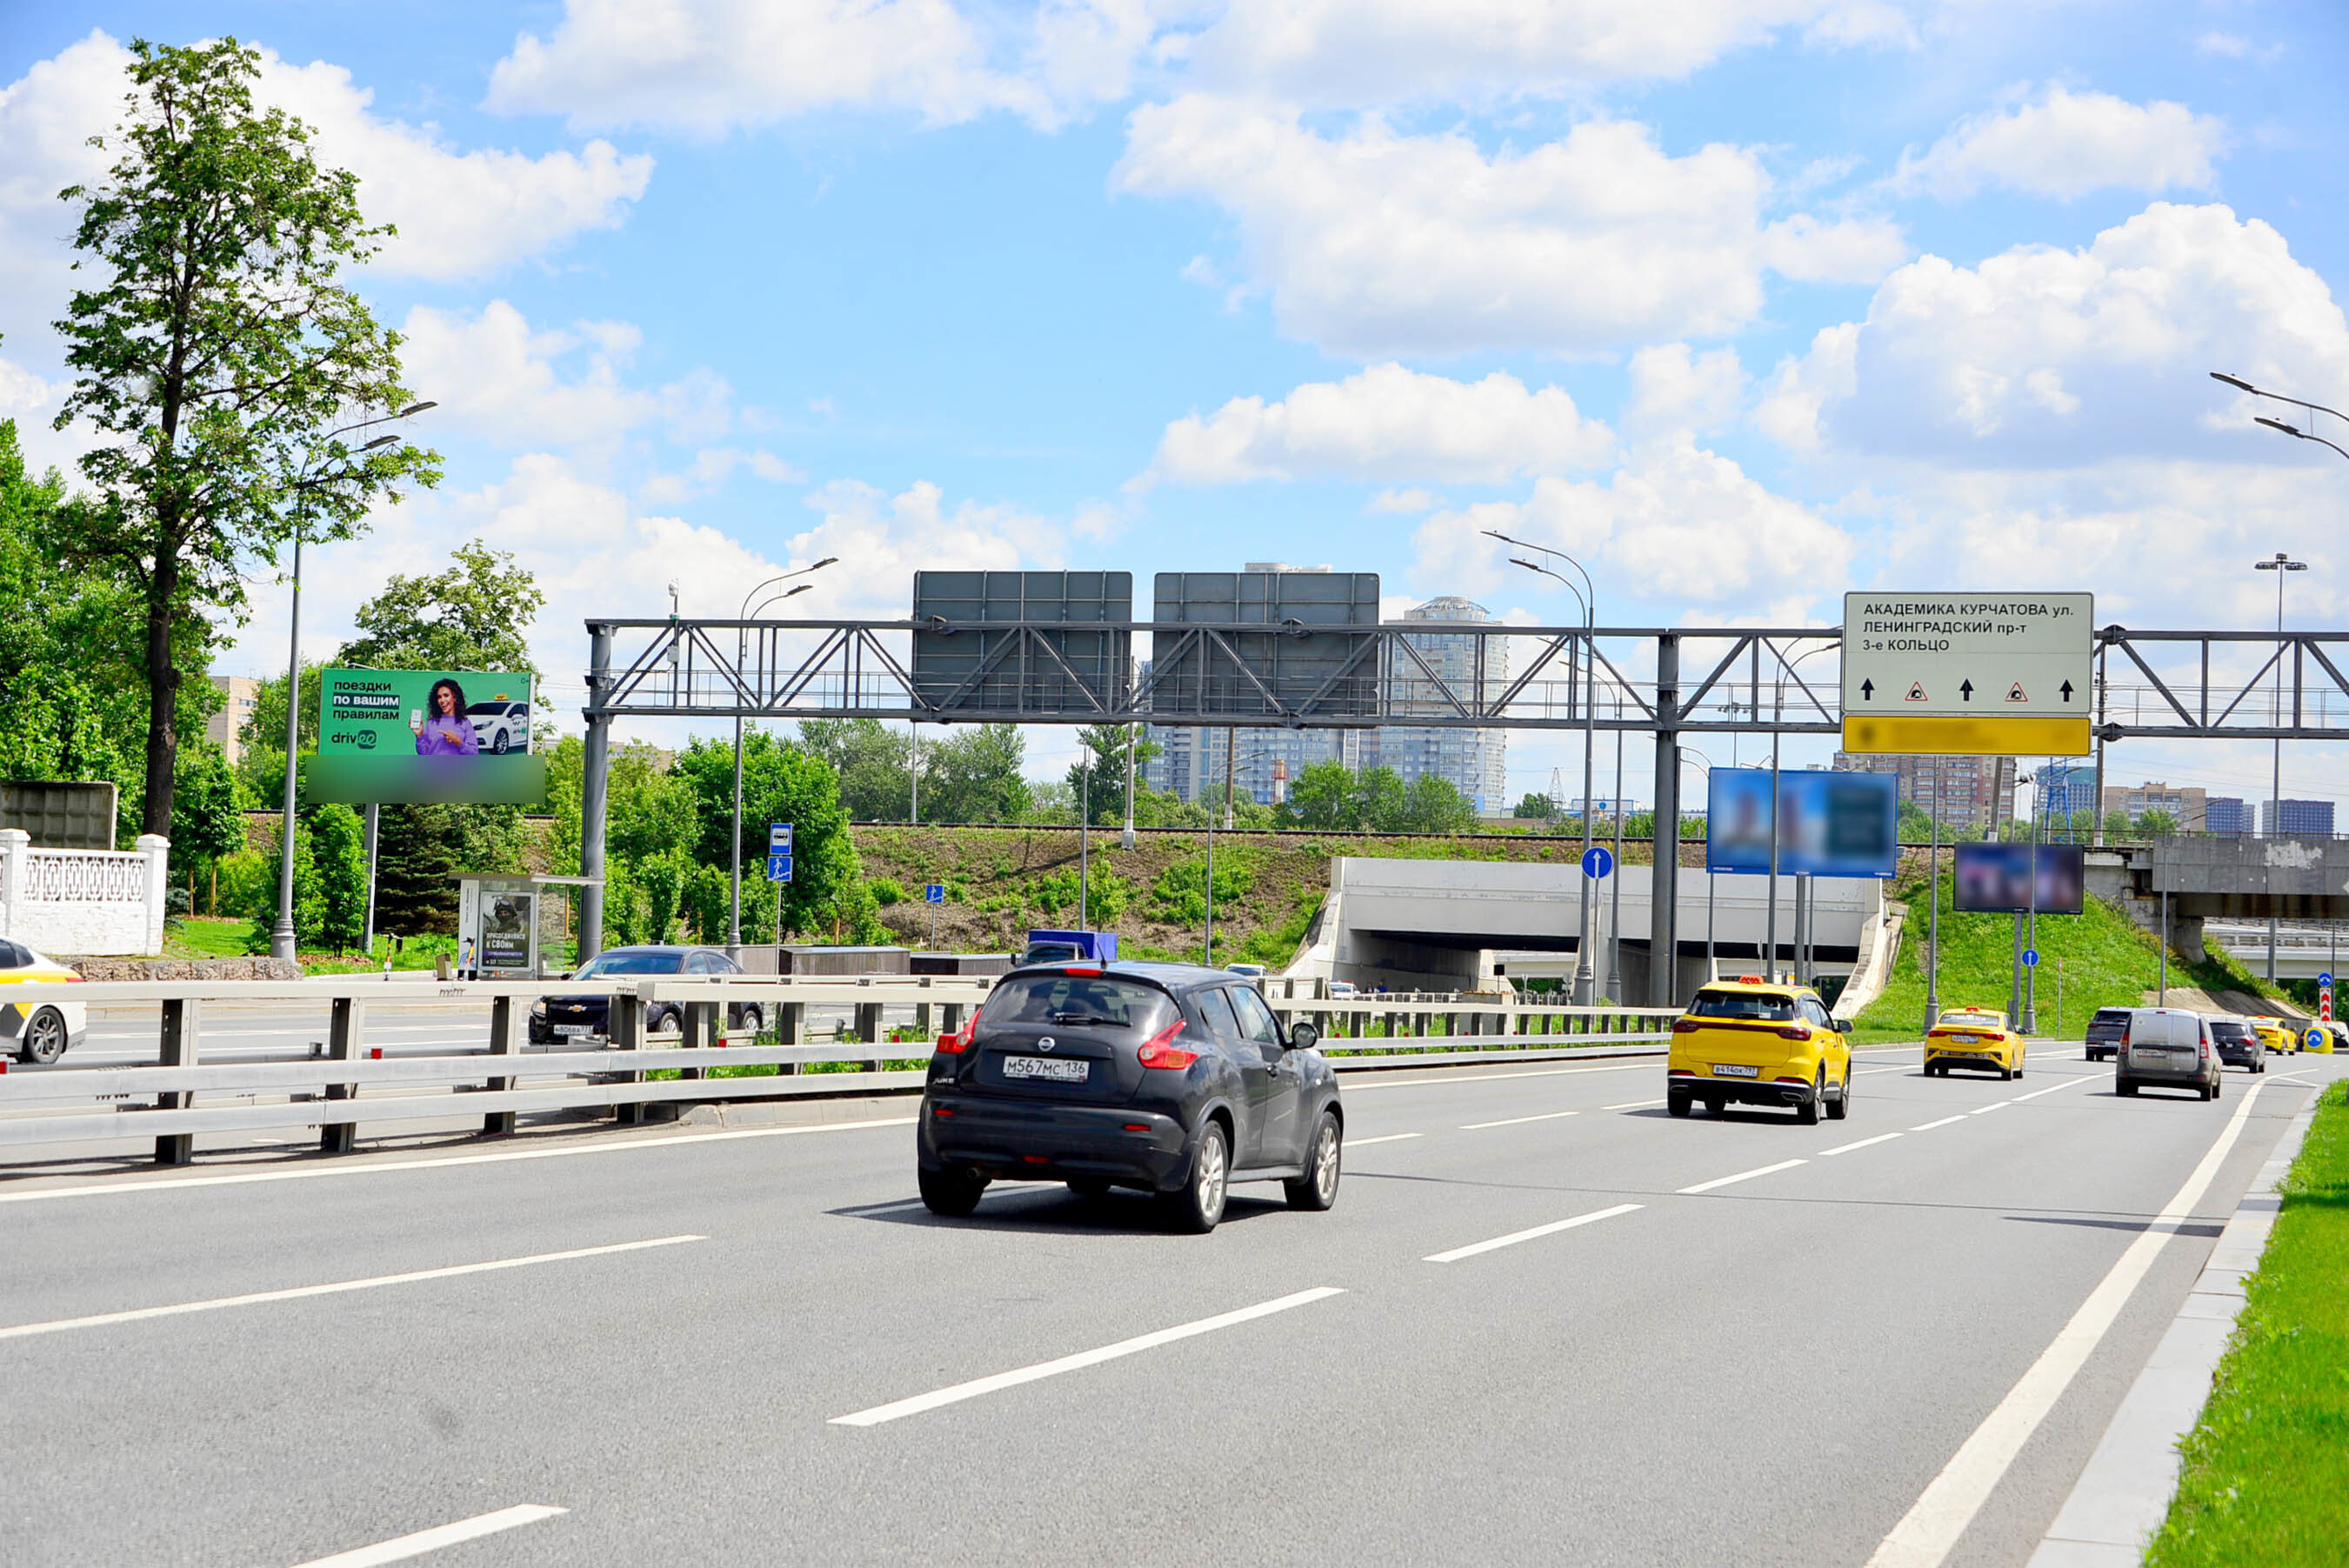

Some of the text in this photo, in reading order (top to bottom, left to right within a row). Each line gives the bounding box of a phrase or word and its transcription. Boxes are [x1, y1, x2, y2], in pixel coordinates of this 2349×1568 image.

[1864, 604, 2074, 618] АКАДЕМИКА КУРЧАТОВА ул.
[1863, 619, 2026, 636] ЛЕНИНГРАДСКИЙ пр-т
[1863, 639, 1950, 652] 3-е КОЛЬЦО
[334, 681, 391, 693] поездки
[333, 695, 399, 706] по вашим
[333, 710, 399, 722] правилам
[1065, 1062, 1086, 1074] 136
